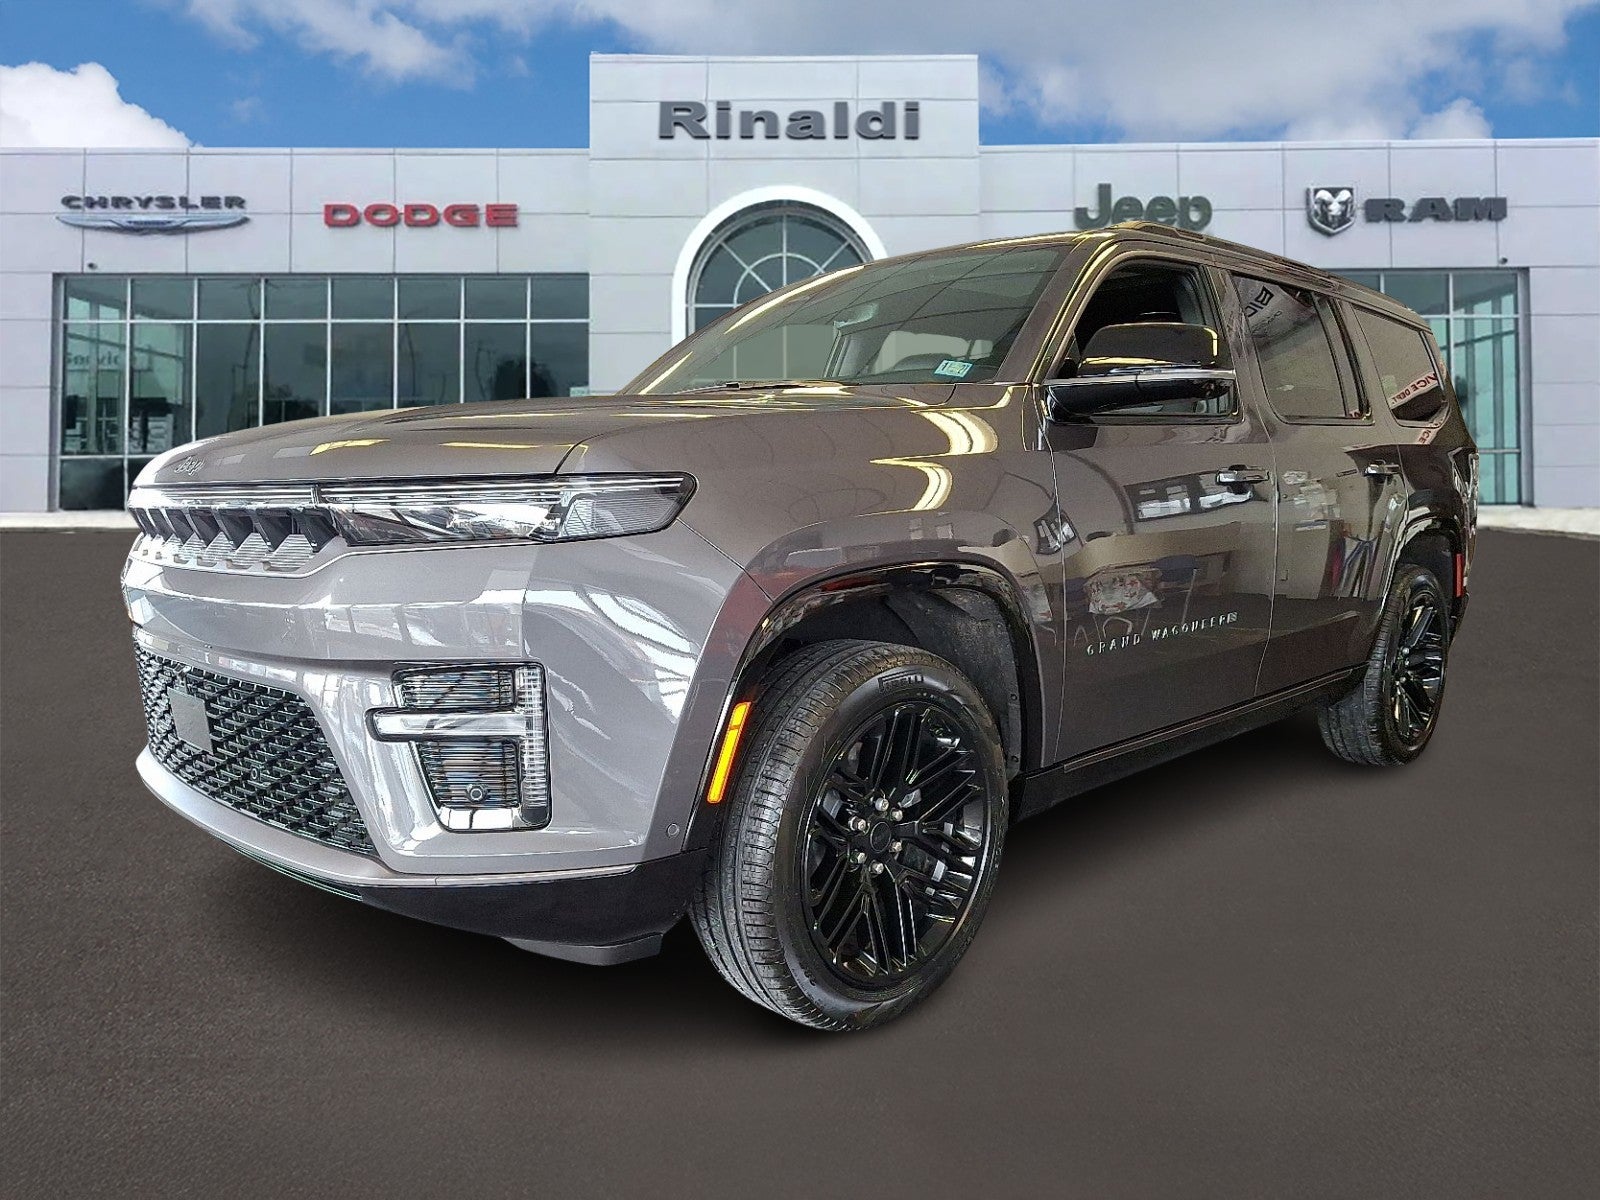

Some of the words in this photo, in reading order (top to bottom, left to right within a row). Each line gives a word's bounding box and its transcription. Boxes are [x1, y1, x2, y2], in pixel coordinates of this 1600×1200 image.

[658, 100, 920, 140] Rinaldi
[61, 195, 247, 210] CHRYSLER
[1074, 183, 1213, 231] Jeep
[1364, 197, 1508, 222] RAM
[323, 203, 519, 228] DODGE
[1086, 633, 1141, 656] GRAND
